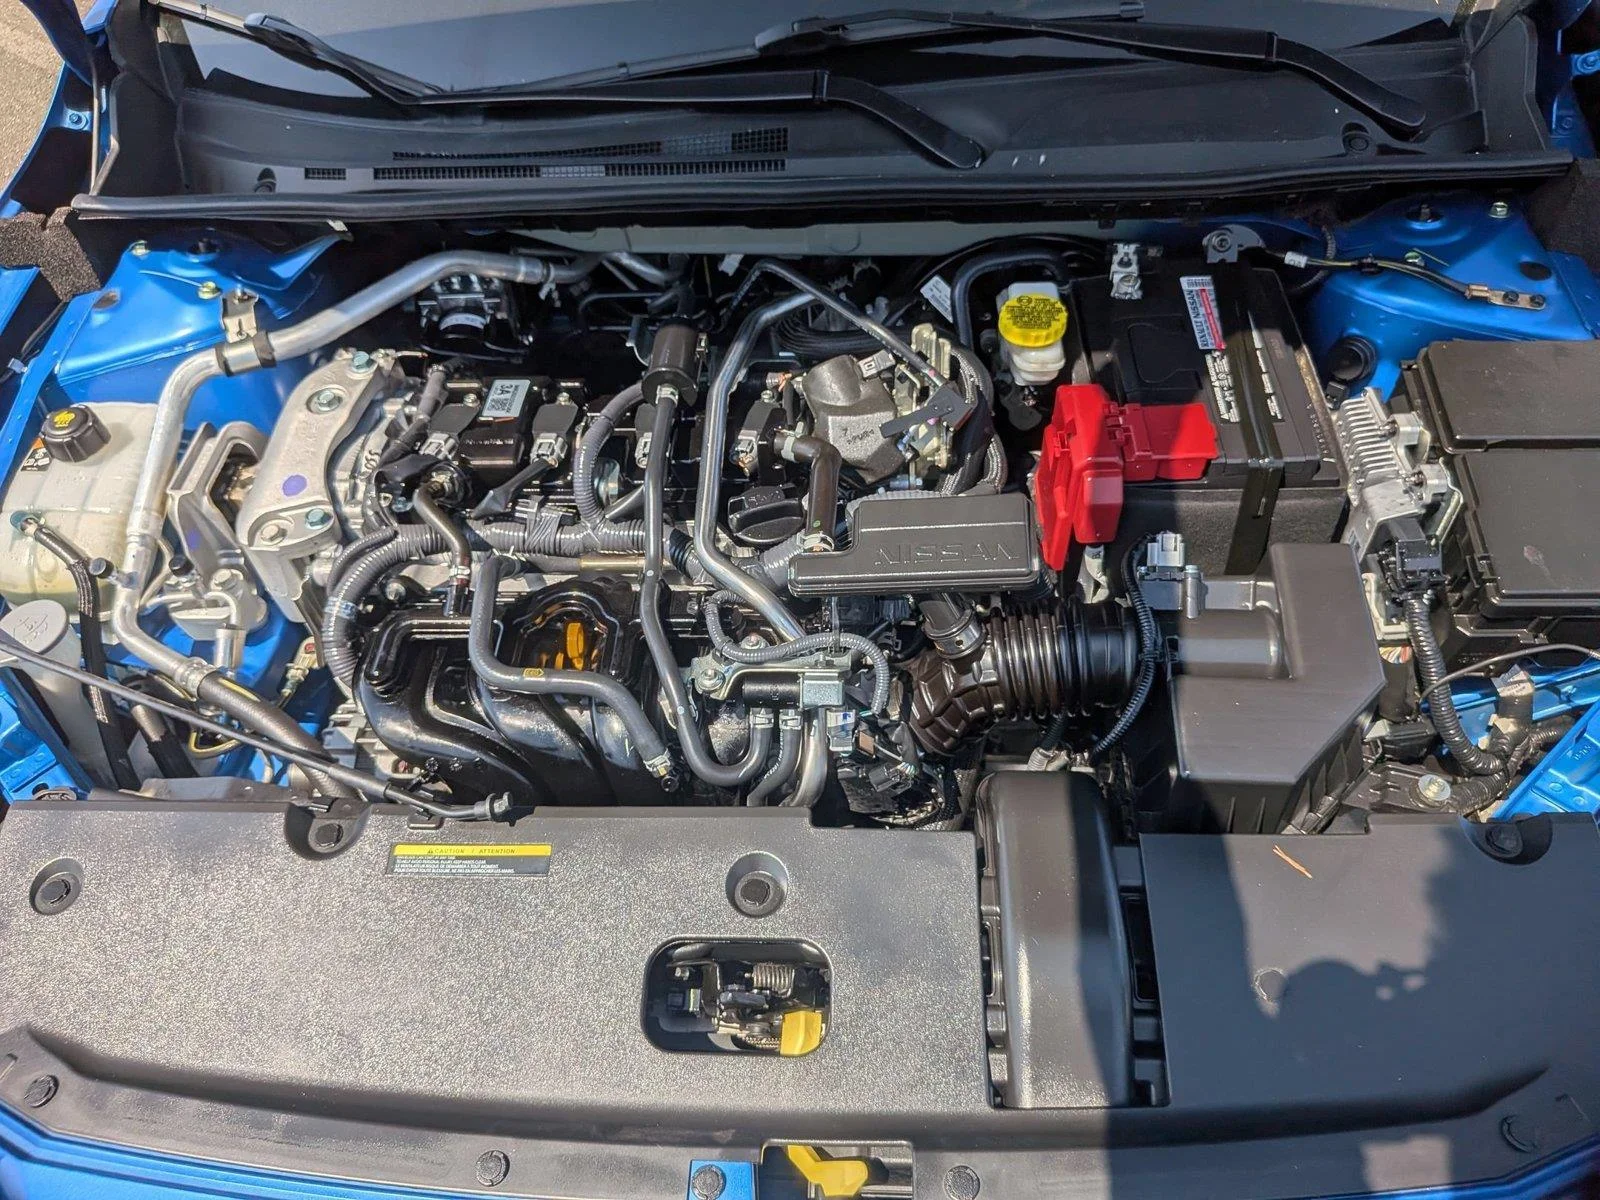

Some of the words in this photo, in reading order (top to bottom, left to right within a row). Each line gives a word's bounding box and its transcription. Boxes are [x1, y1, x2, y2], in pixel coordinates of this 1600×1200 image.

[1186, 290, 1200, 320] NISSAN
[500, 384, 514, 395] 3A
[875, 542, 1020, 565] NISSAN
